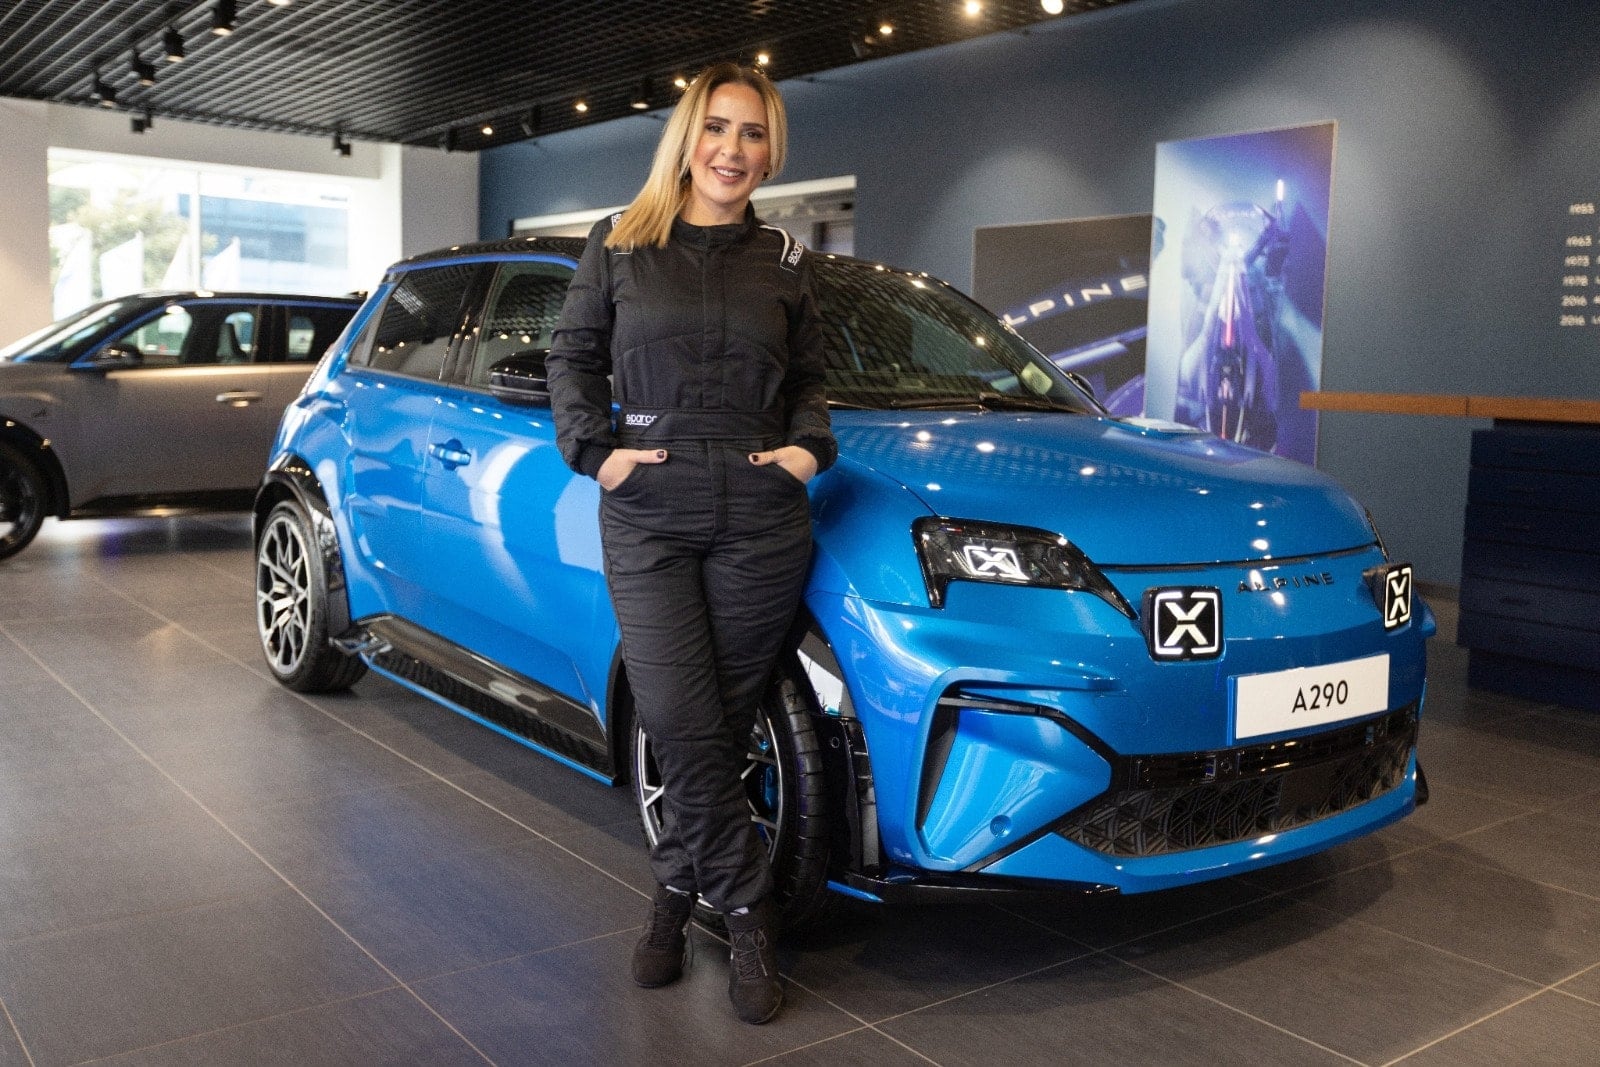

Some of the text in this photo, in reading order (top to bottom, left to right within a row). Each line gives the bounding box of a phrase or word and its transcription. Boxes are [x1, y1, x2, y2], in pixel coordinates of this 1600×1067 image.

[1000, 274, 1147, 327] LPINE
[1237, 572, 1334, 593] ALPINE
[1292, 680, 1349, 713] A290
